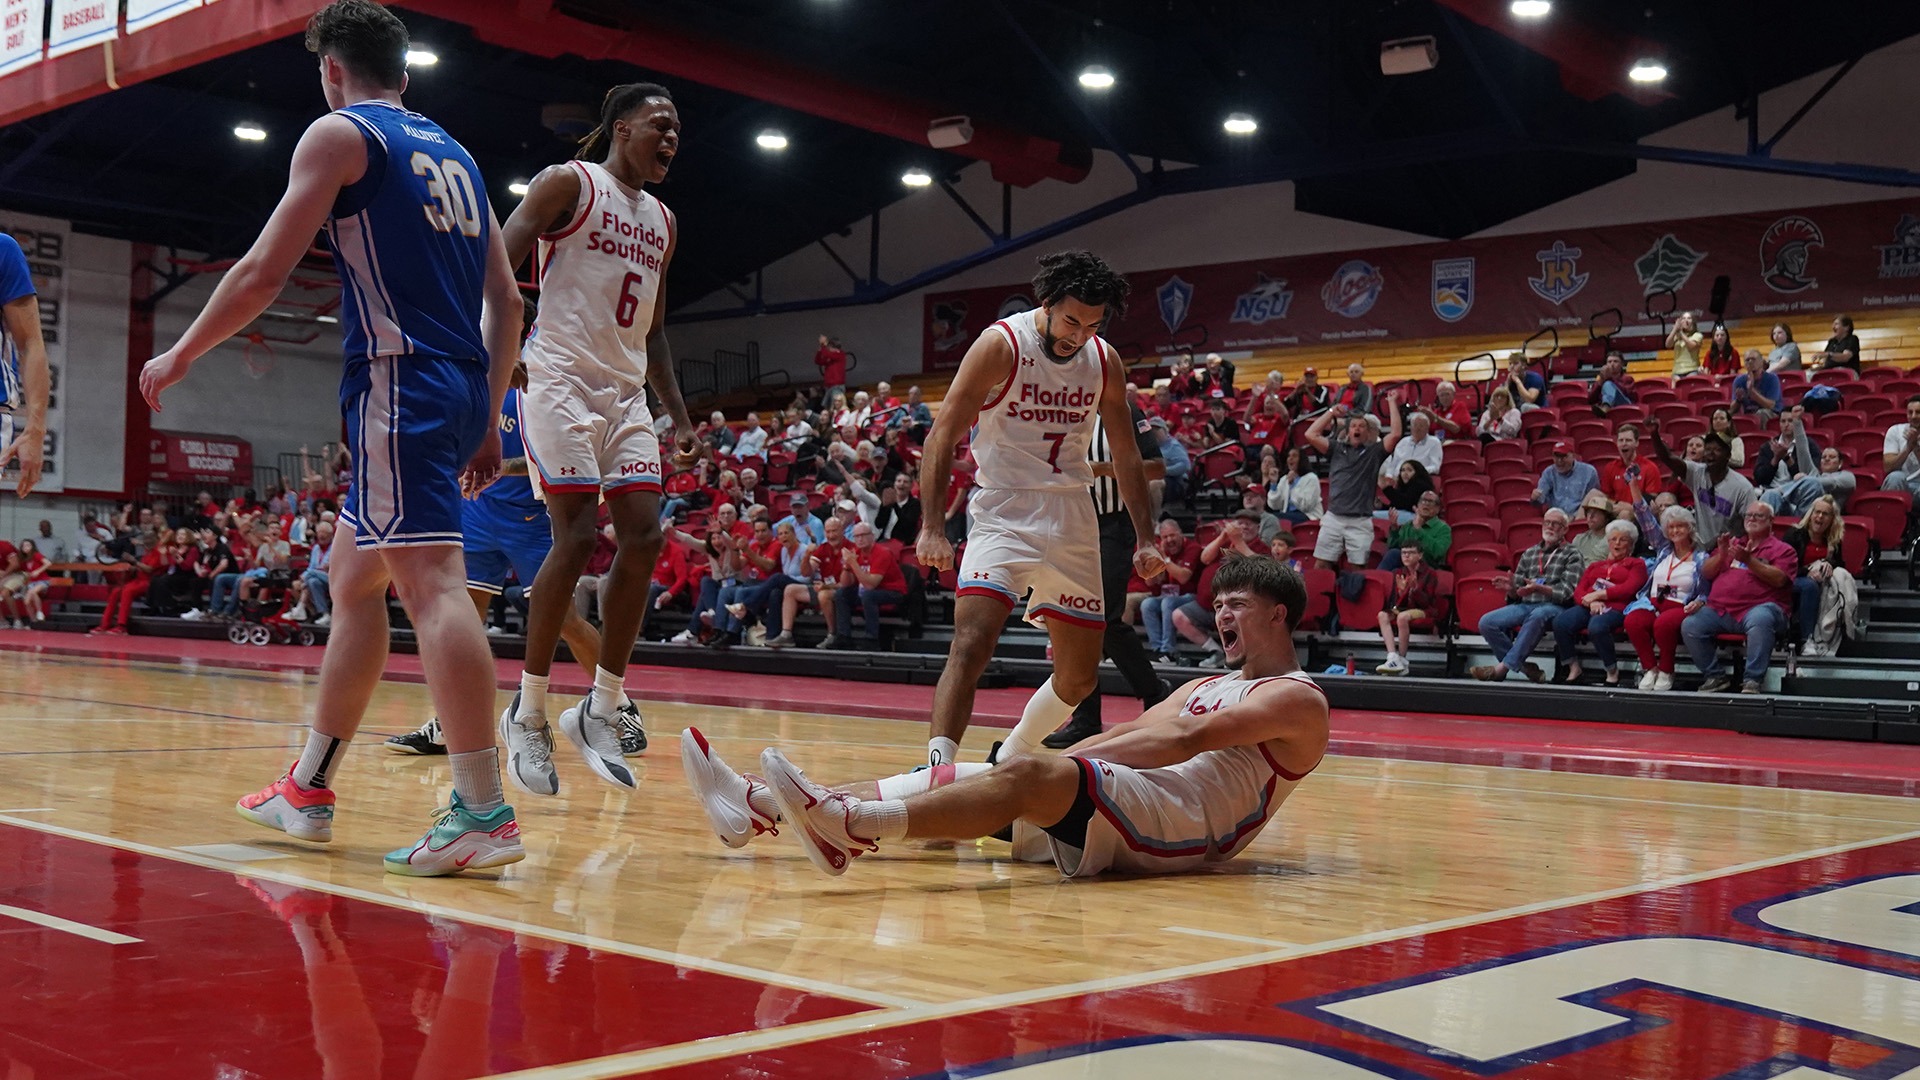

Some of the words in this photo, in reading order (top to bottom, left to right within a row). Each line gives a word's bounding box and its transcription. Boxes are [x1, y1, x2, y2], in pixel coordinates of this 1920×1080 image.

[63, 4, 105, 30] BASEBALL
[410, 150, 481, 237] 30
[603, 211, 664, 251] Florida
[616, 271, 642, 328] 6
[1235, 294, 1291, 322] NSU
[1754, 302, 1789, 312] University
[1790, 301, 1799, 310] of
[1800, 300, 1824, 311] Tampa
[1020, 383, 1096, 407] Florida
[1007, 401, 1091, 424] Souther
[1043, 432, 1068, 474] 7
[620, 461, 660, 476] MOCS
[1059, 593, 1101, 612] MOCS
